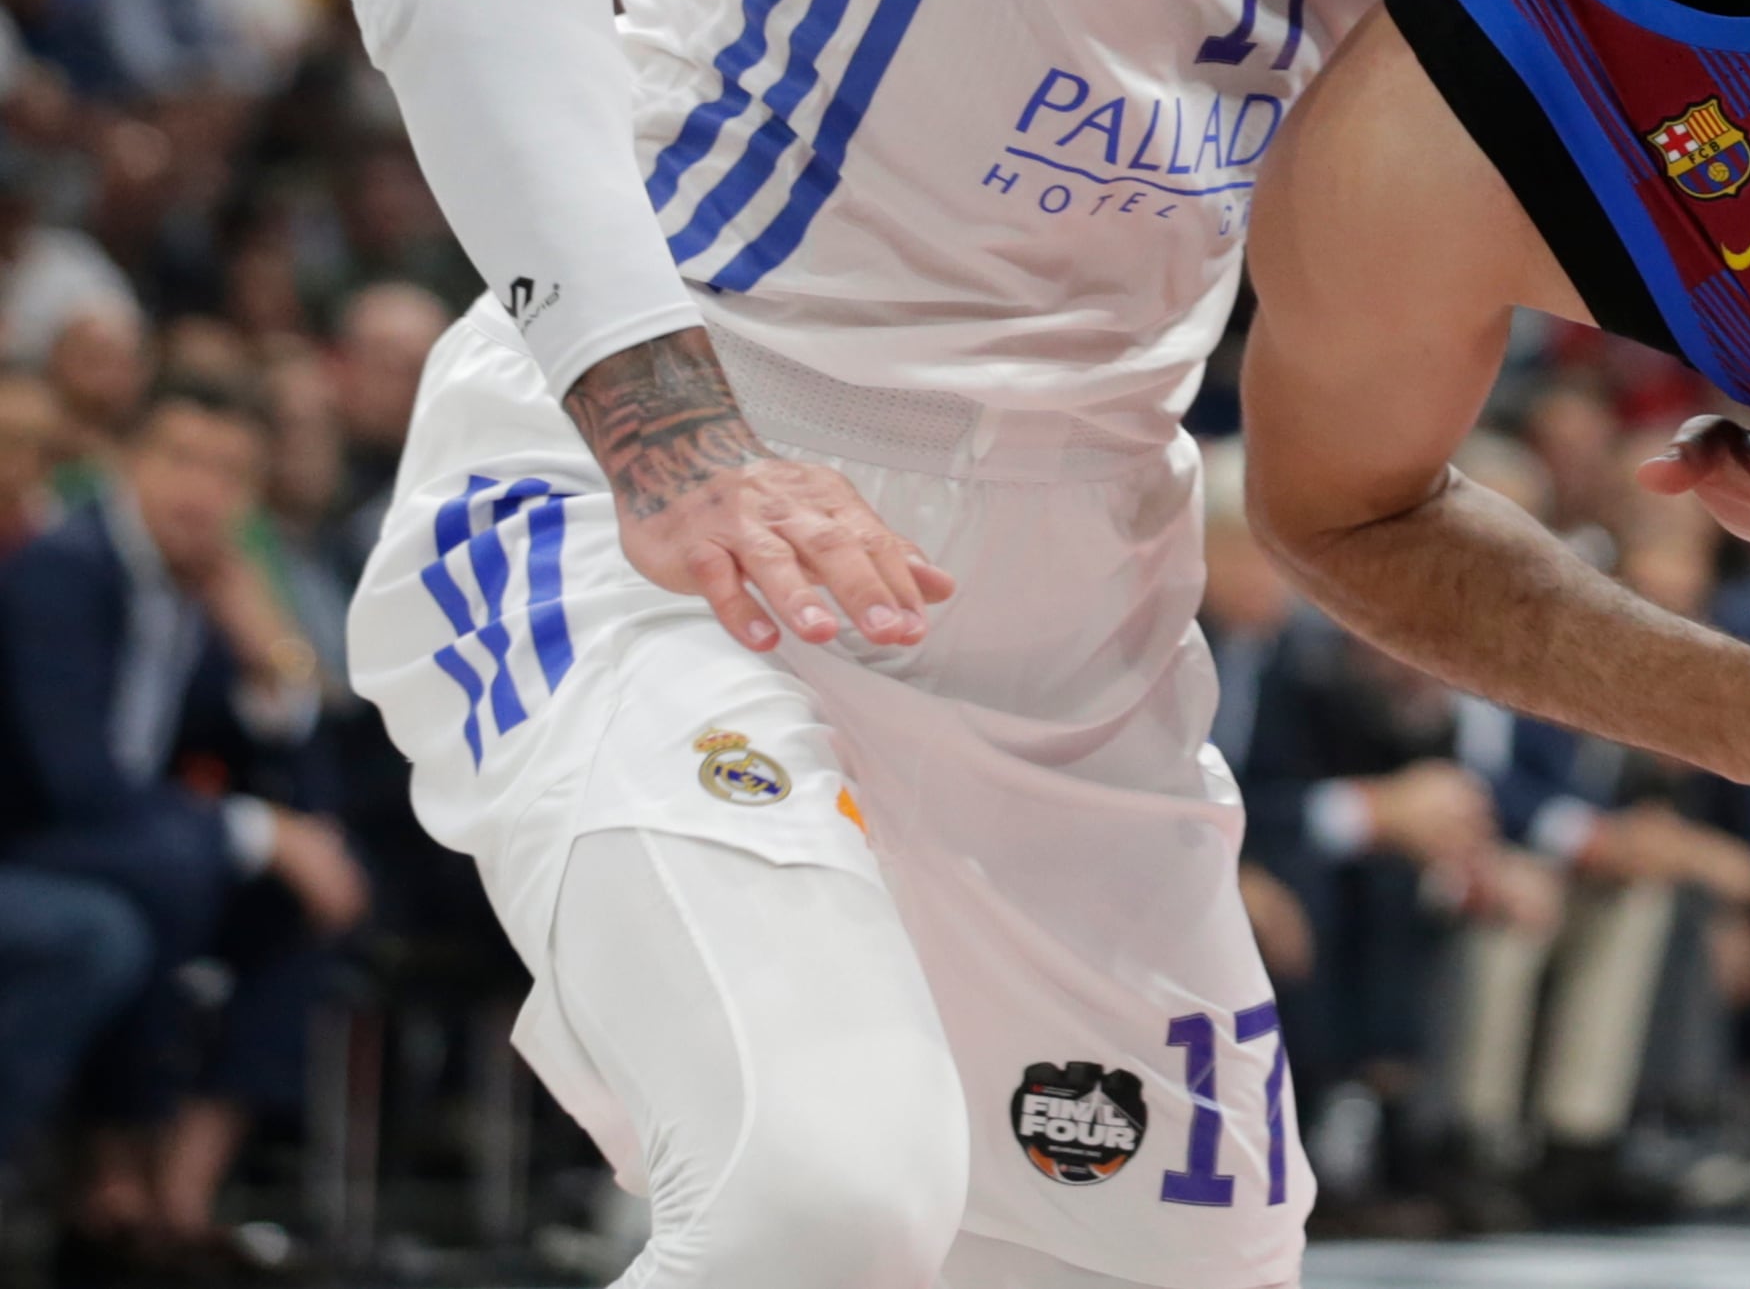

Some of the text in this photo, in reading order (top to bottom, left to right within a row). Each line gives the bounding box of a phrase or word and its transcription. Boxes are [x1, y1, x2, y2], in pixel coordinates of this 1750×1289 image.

[1015, 67, 1283, 175] PALLAD
[981, 163, 1178, 218] HOTEL
[1019, 1112, 1136, 1151] FOUR
[1160, 999, 1287, 1208] 17
